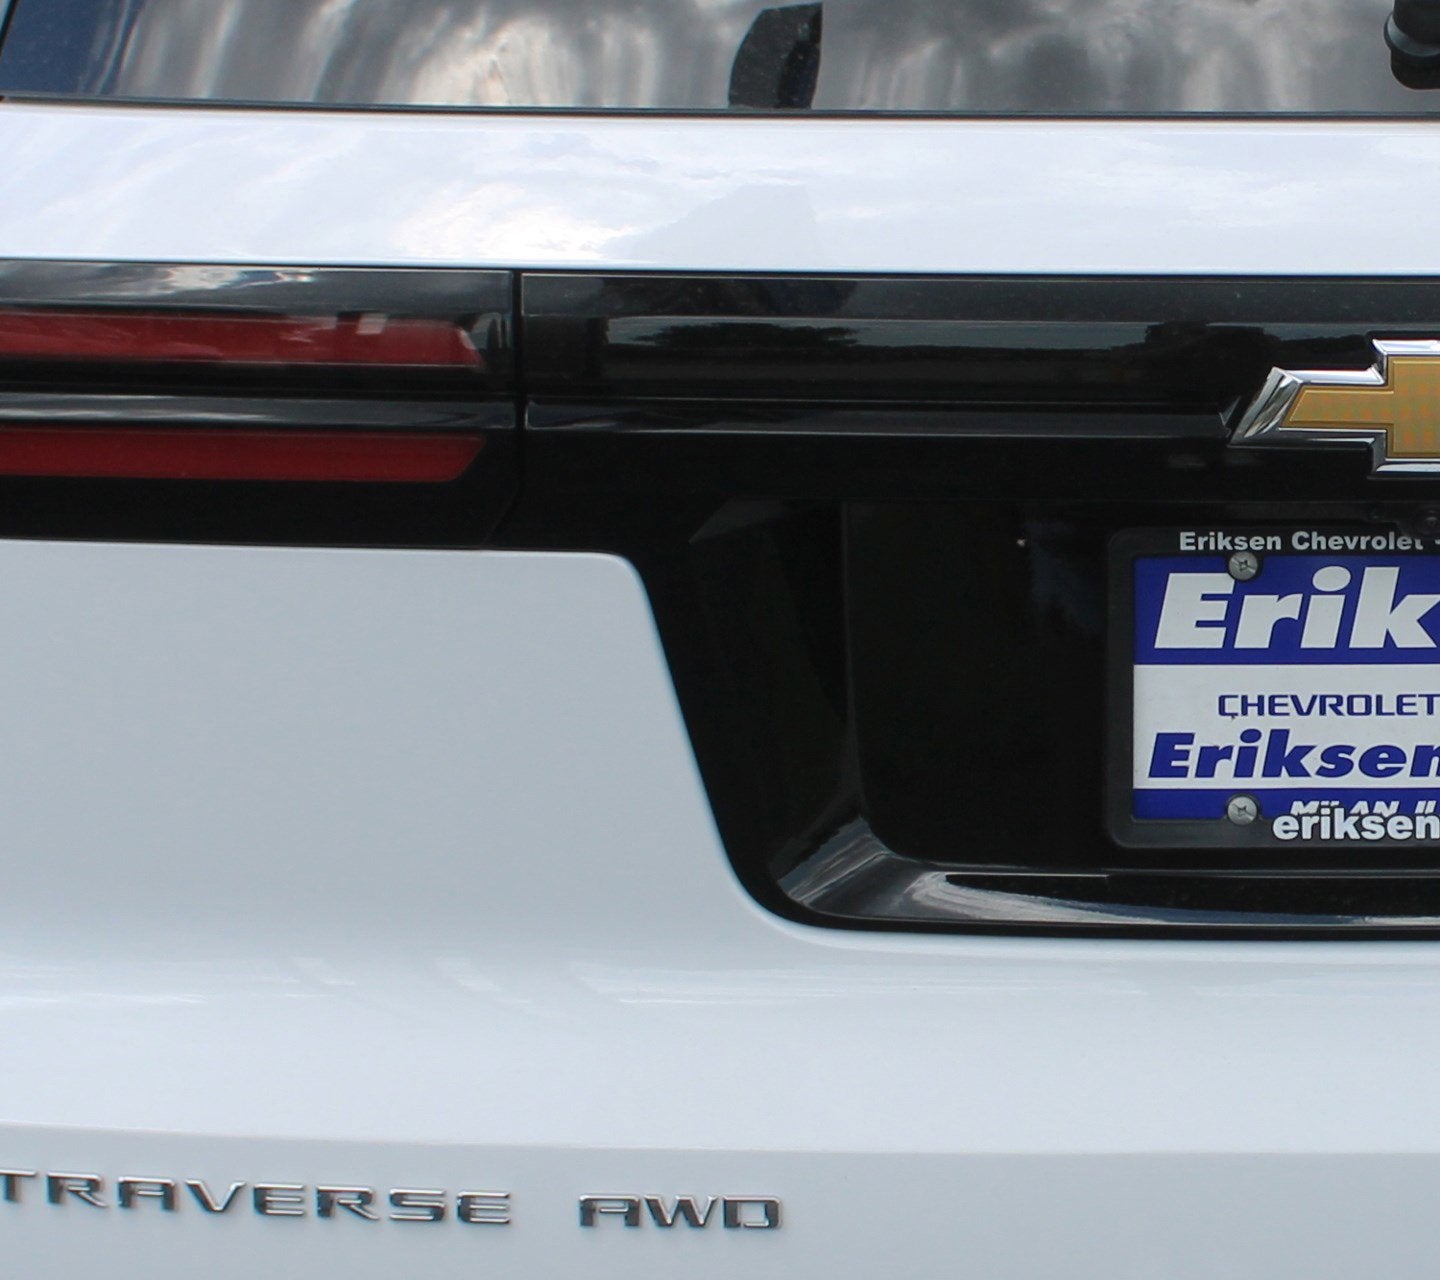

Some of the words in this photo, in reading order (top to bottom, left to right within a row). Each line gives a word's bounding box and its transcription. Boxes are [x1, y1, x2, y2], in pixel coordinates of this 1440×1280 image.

[1179, 531, 1282, 550] Eriksen
[1291, 531, 1424, 551] Chevrolet
[578, 1193, 784, 1230] AWD
